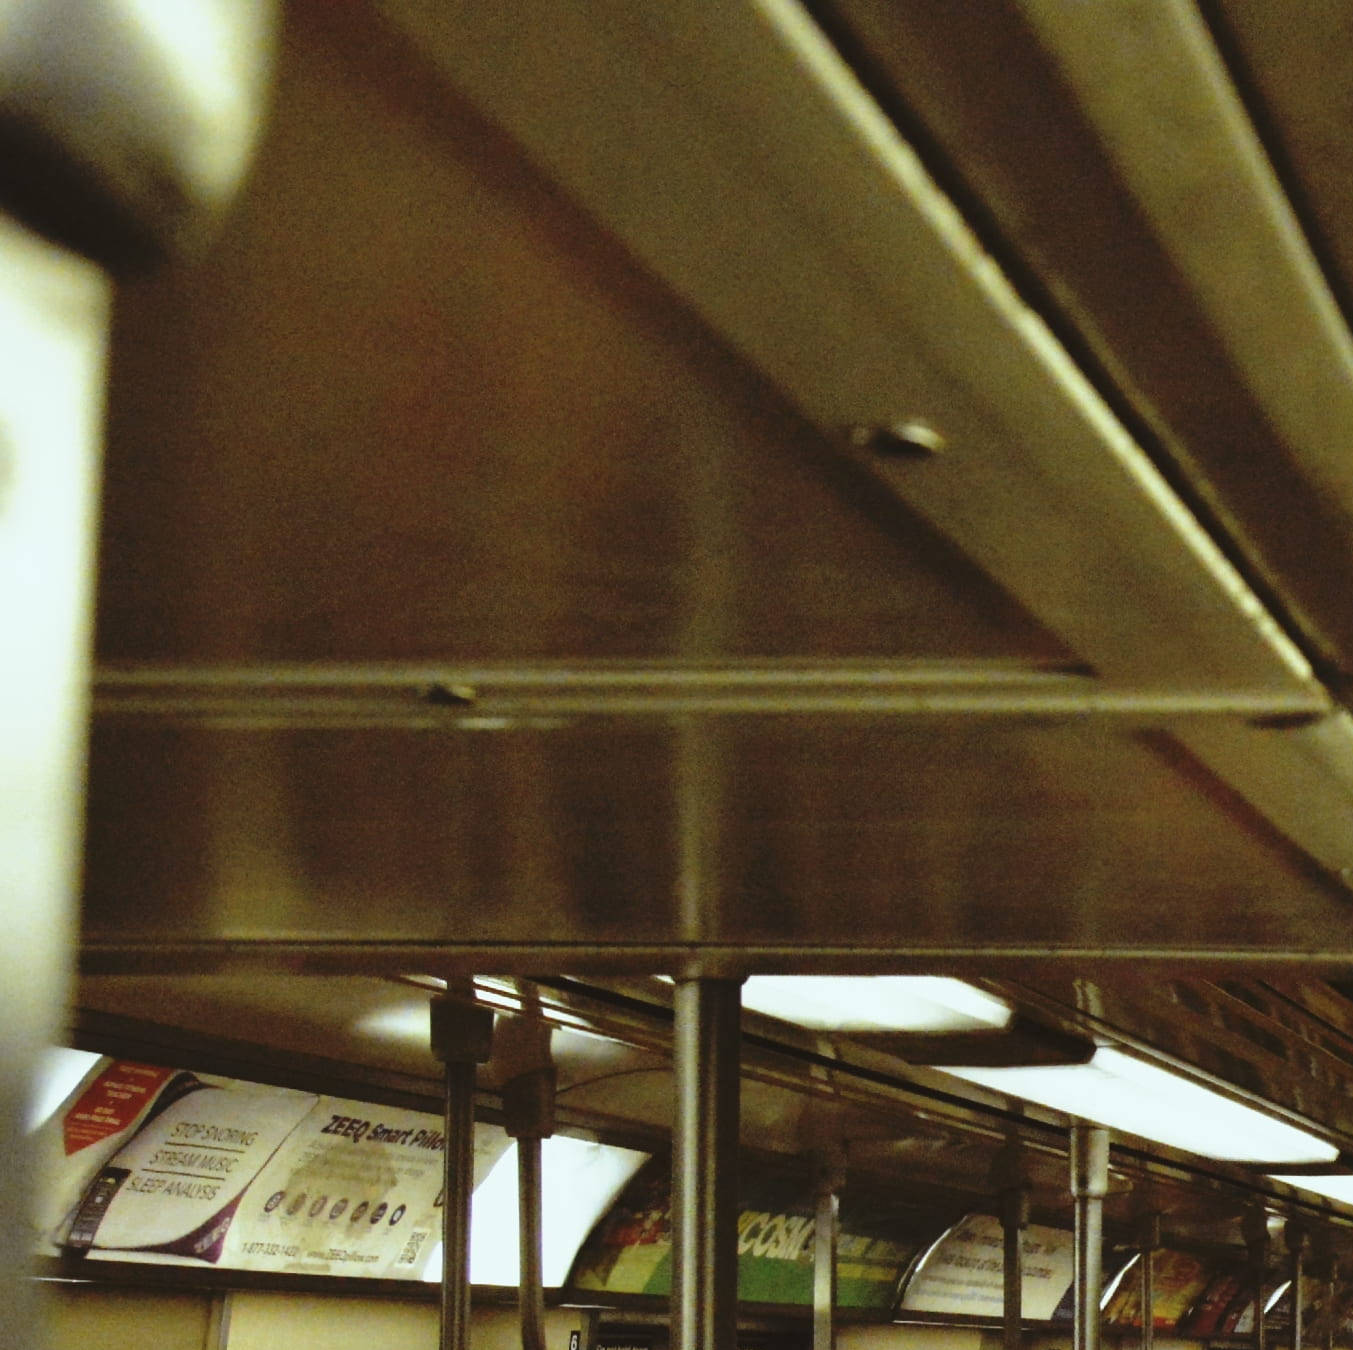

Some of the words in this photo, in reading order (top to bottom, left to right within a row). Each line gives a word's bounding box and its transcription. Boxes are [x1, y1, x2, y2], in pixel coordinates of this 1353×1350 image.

[170, 1121, 204, 1138] STOP
[206, 1126, 259, 1146] SNORING
[321, 1114, 371, 1143] ZEEQ
[366, 1123, 414, 1145] Smart
[411, 1129, 446, 1151] Pillo
[149, 1150, 201, 1169] STREAM
[200, 1154, 239, 1173] MUSIC
[126, 1177, 167, 1194] SLEEP
[164, 1181, 221, 1201] ANALYSIS
